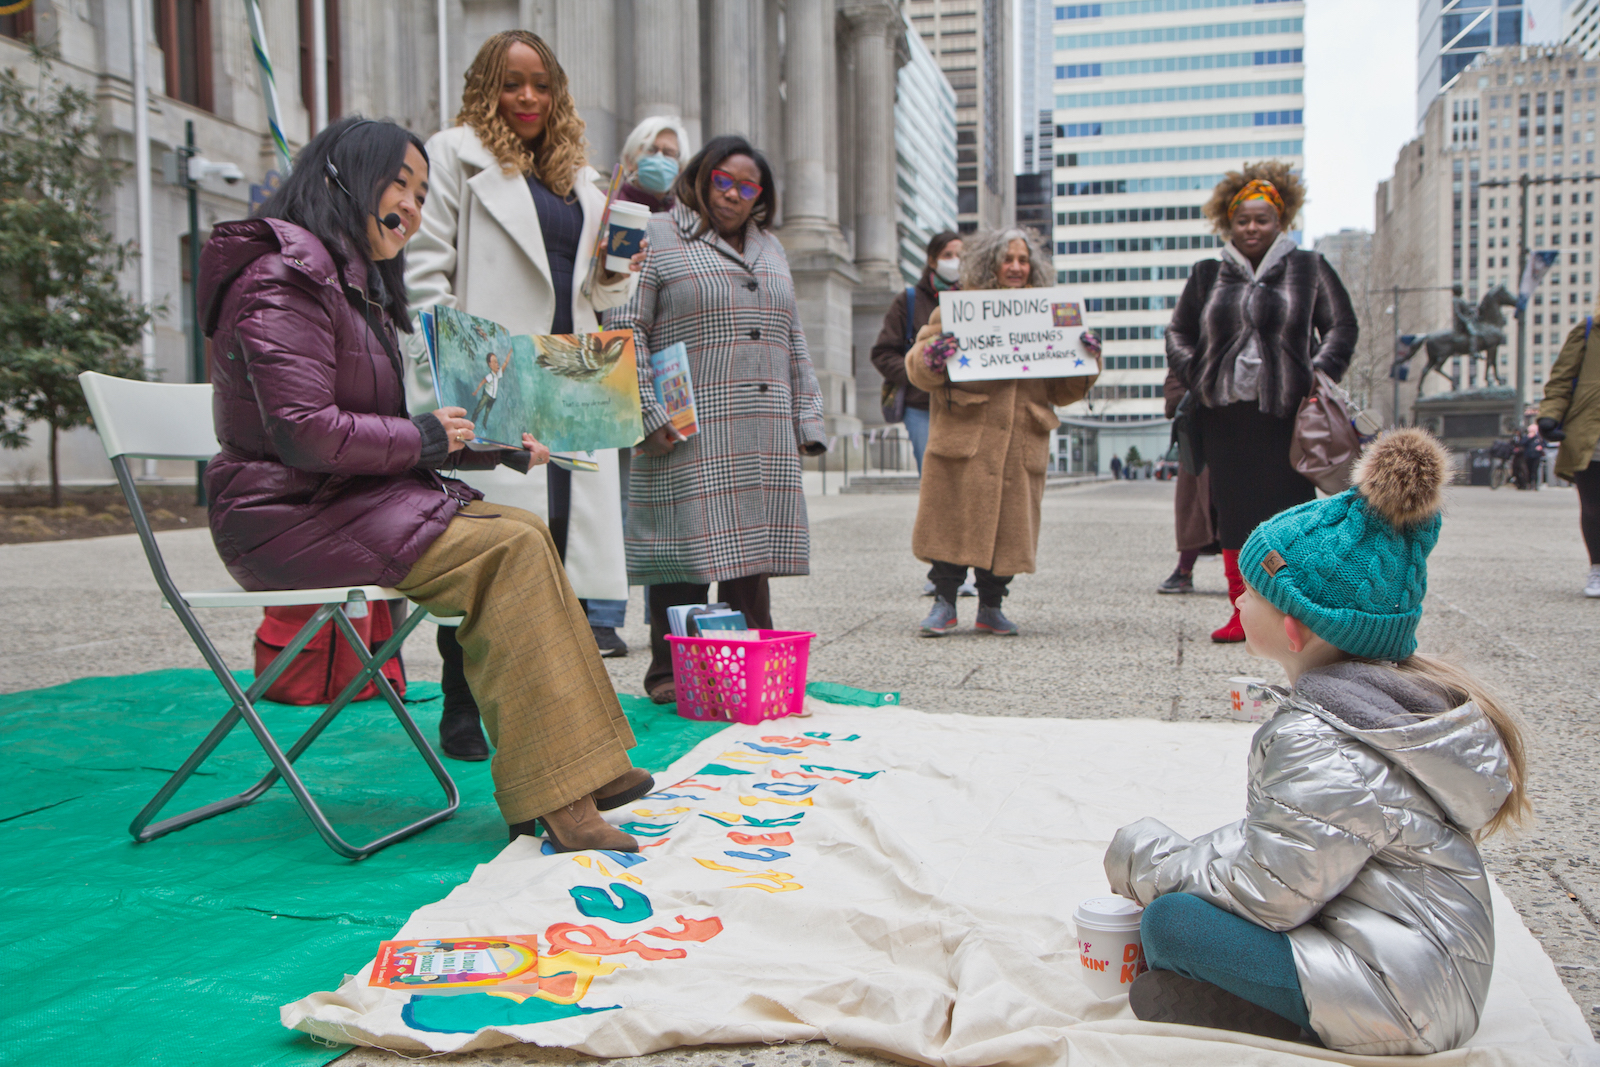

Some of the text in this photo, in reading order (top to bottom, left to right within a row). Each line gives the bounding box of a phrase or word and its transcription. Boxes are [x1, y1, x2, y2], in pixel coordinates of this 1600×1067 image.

[952, 300, 975, 323] NO
[982, 299, 1049, 320] FUNDING
[958, 330, 1063, 351] UNSAFE BUILDINGS
[980, 350, 1076, 368] SAVE OUR LIBRARIES
[653, 361, 681, 380] ibrary
[419, 954, 435, 973] BOOKCASE
[443, 956, 456, 964] YOU
[462, 959, 476, 969] BUILD
